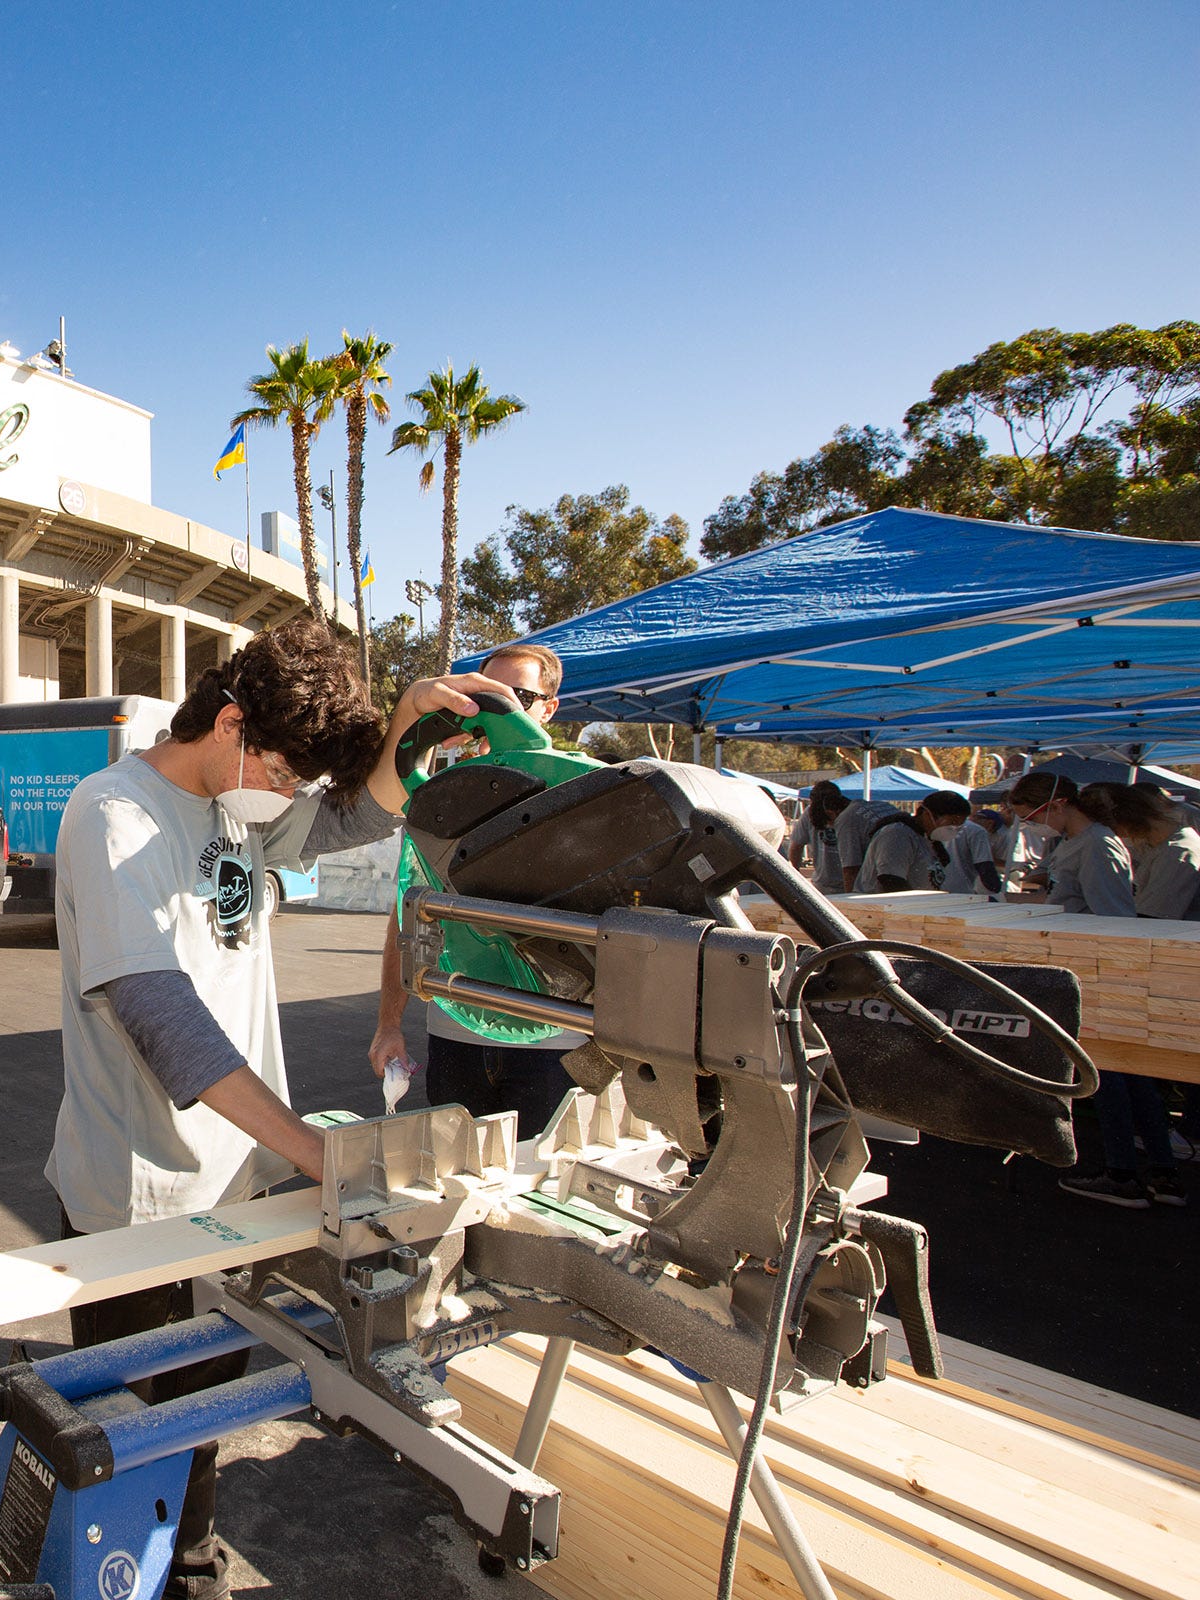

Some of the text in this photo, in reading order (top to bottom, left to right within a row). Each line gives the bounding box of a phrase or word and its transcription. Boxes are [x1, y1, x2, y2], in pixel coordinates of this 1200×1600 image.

[10, 774, 80, 784] NO KID SLEEPS
[10, 788, 73, 798] ON THE FLOO
[11, 801, 67, 811] IN OUR TOW
[957, 1013, 1026, 1034] HPT
[15, 1440, 56, 1493] KOBALT
